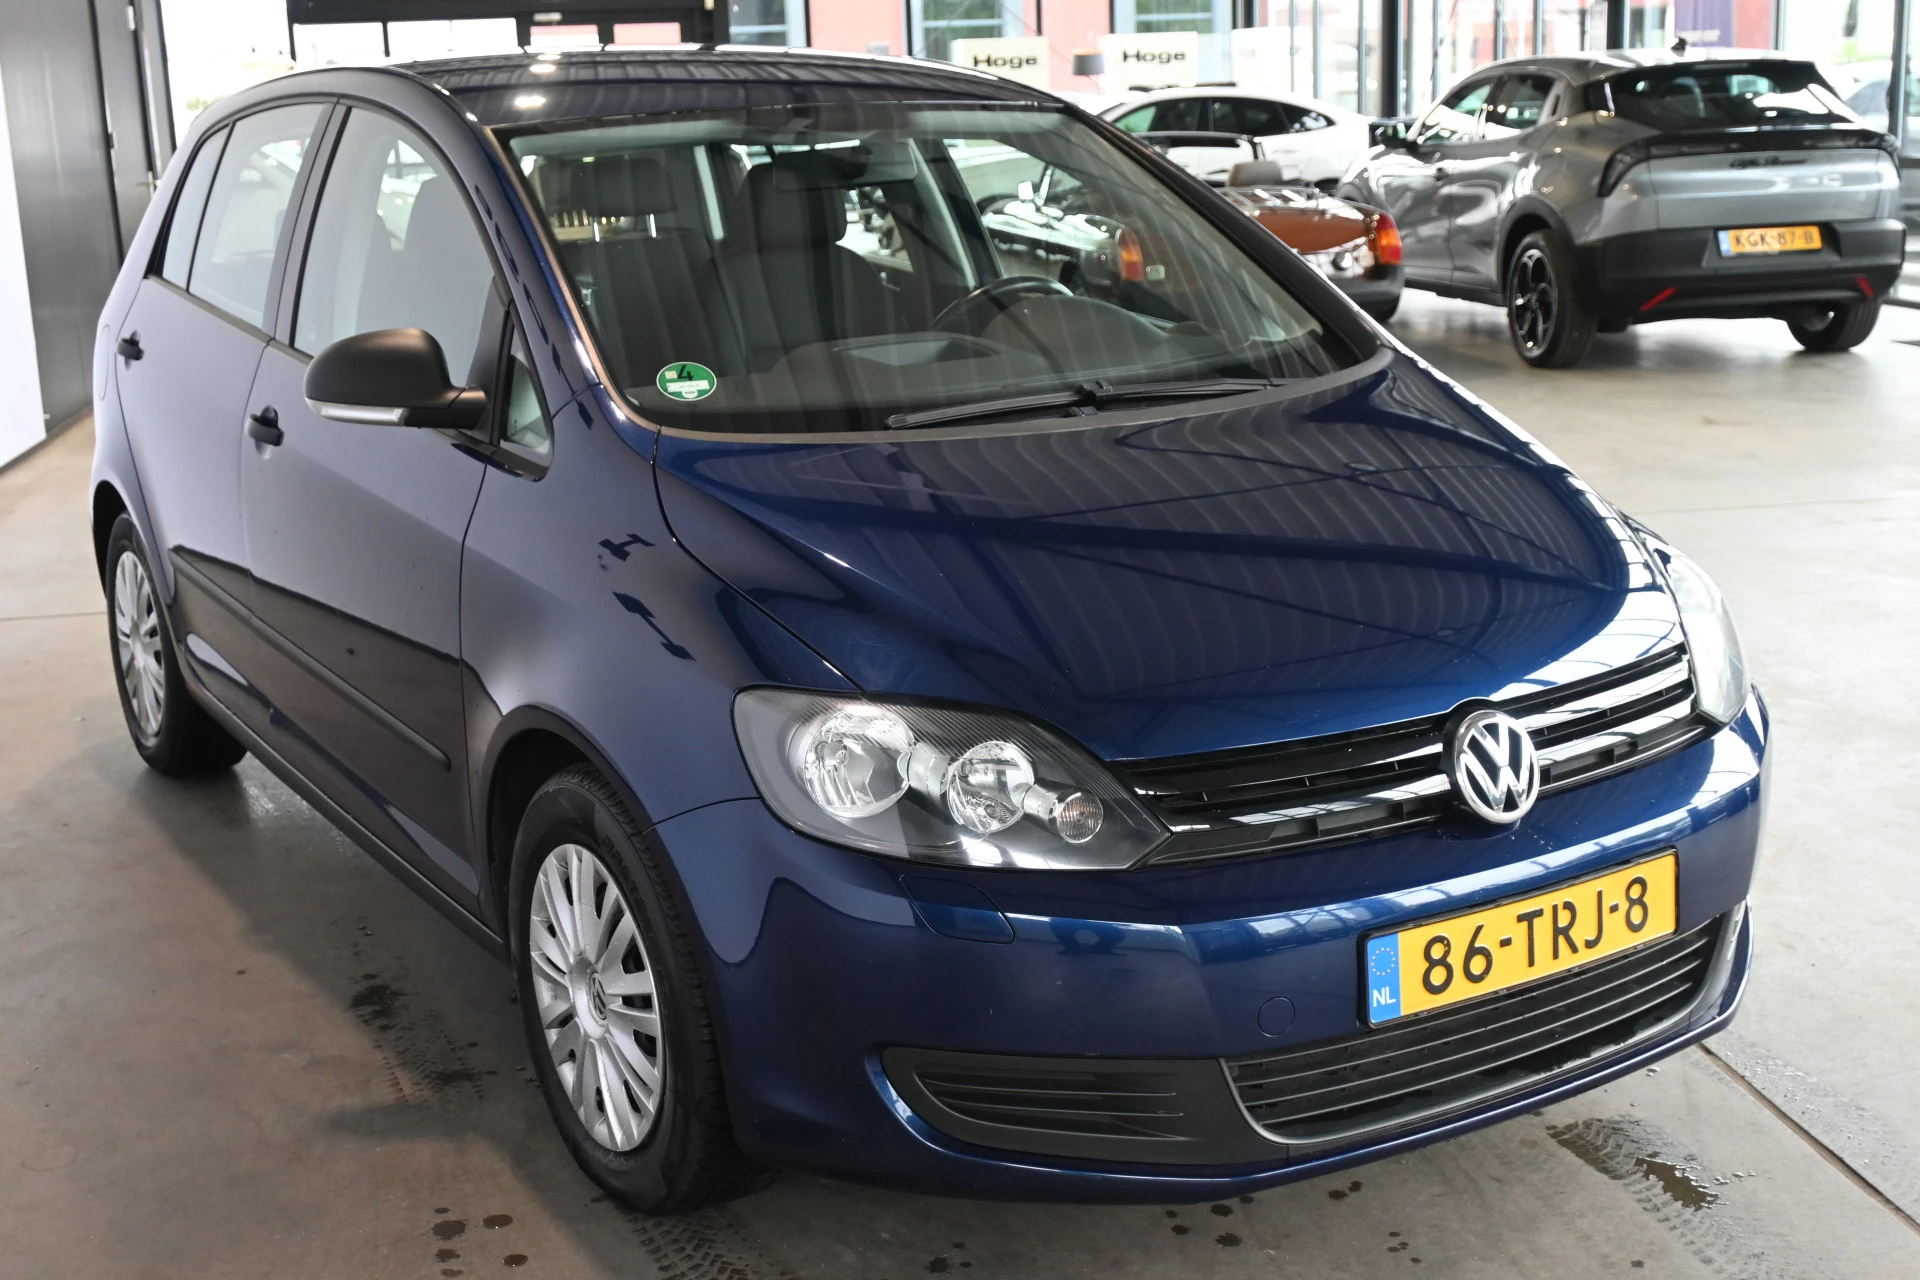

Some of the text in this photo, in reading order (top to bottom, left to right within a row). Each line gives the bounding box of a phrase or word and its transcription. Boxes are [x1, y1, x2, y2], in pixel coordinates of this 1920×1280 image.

[973, 55, 1038, 69] Hoge
[1122, 50, 1187, 64] Hoge
[677, 364, 694, 381] 4
[1422, 875, 1649, 995] 86-TRJ-8
[1372, 986, 1396, 1007] NL
